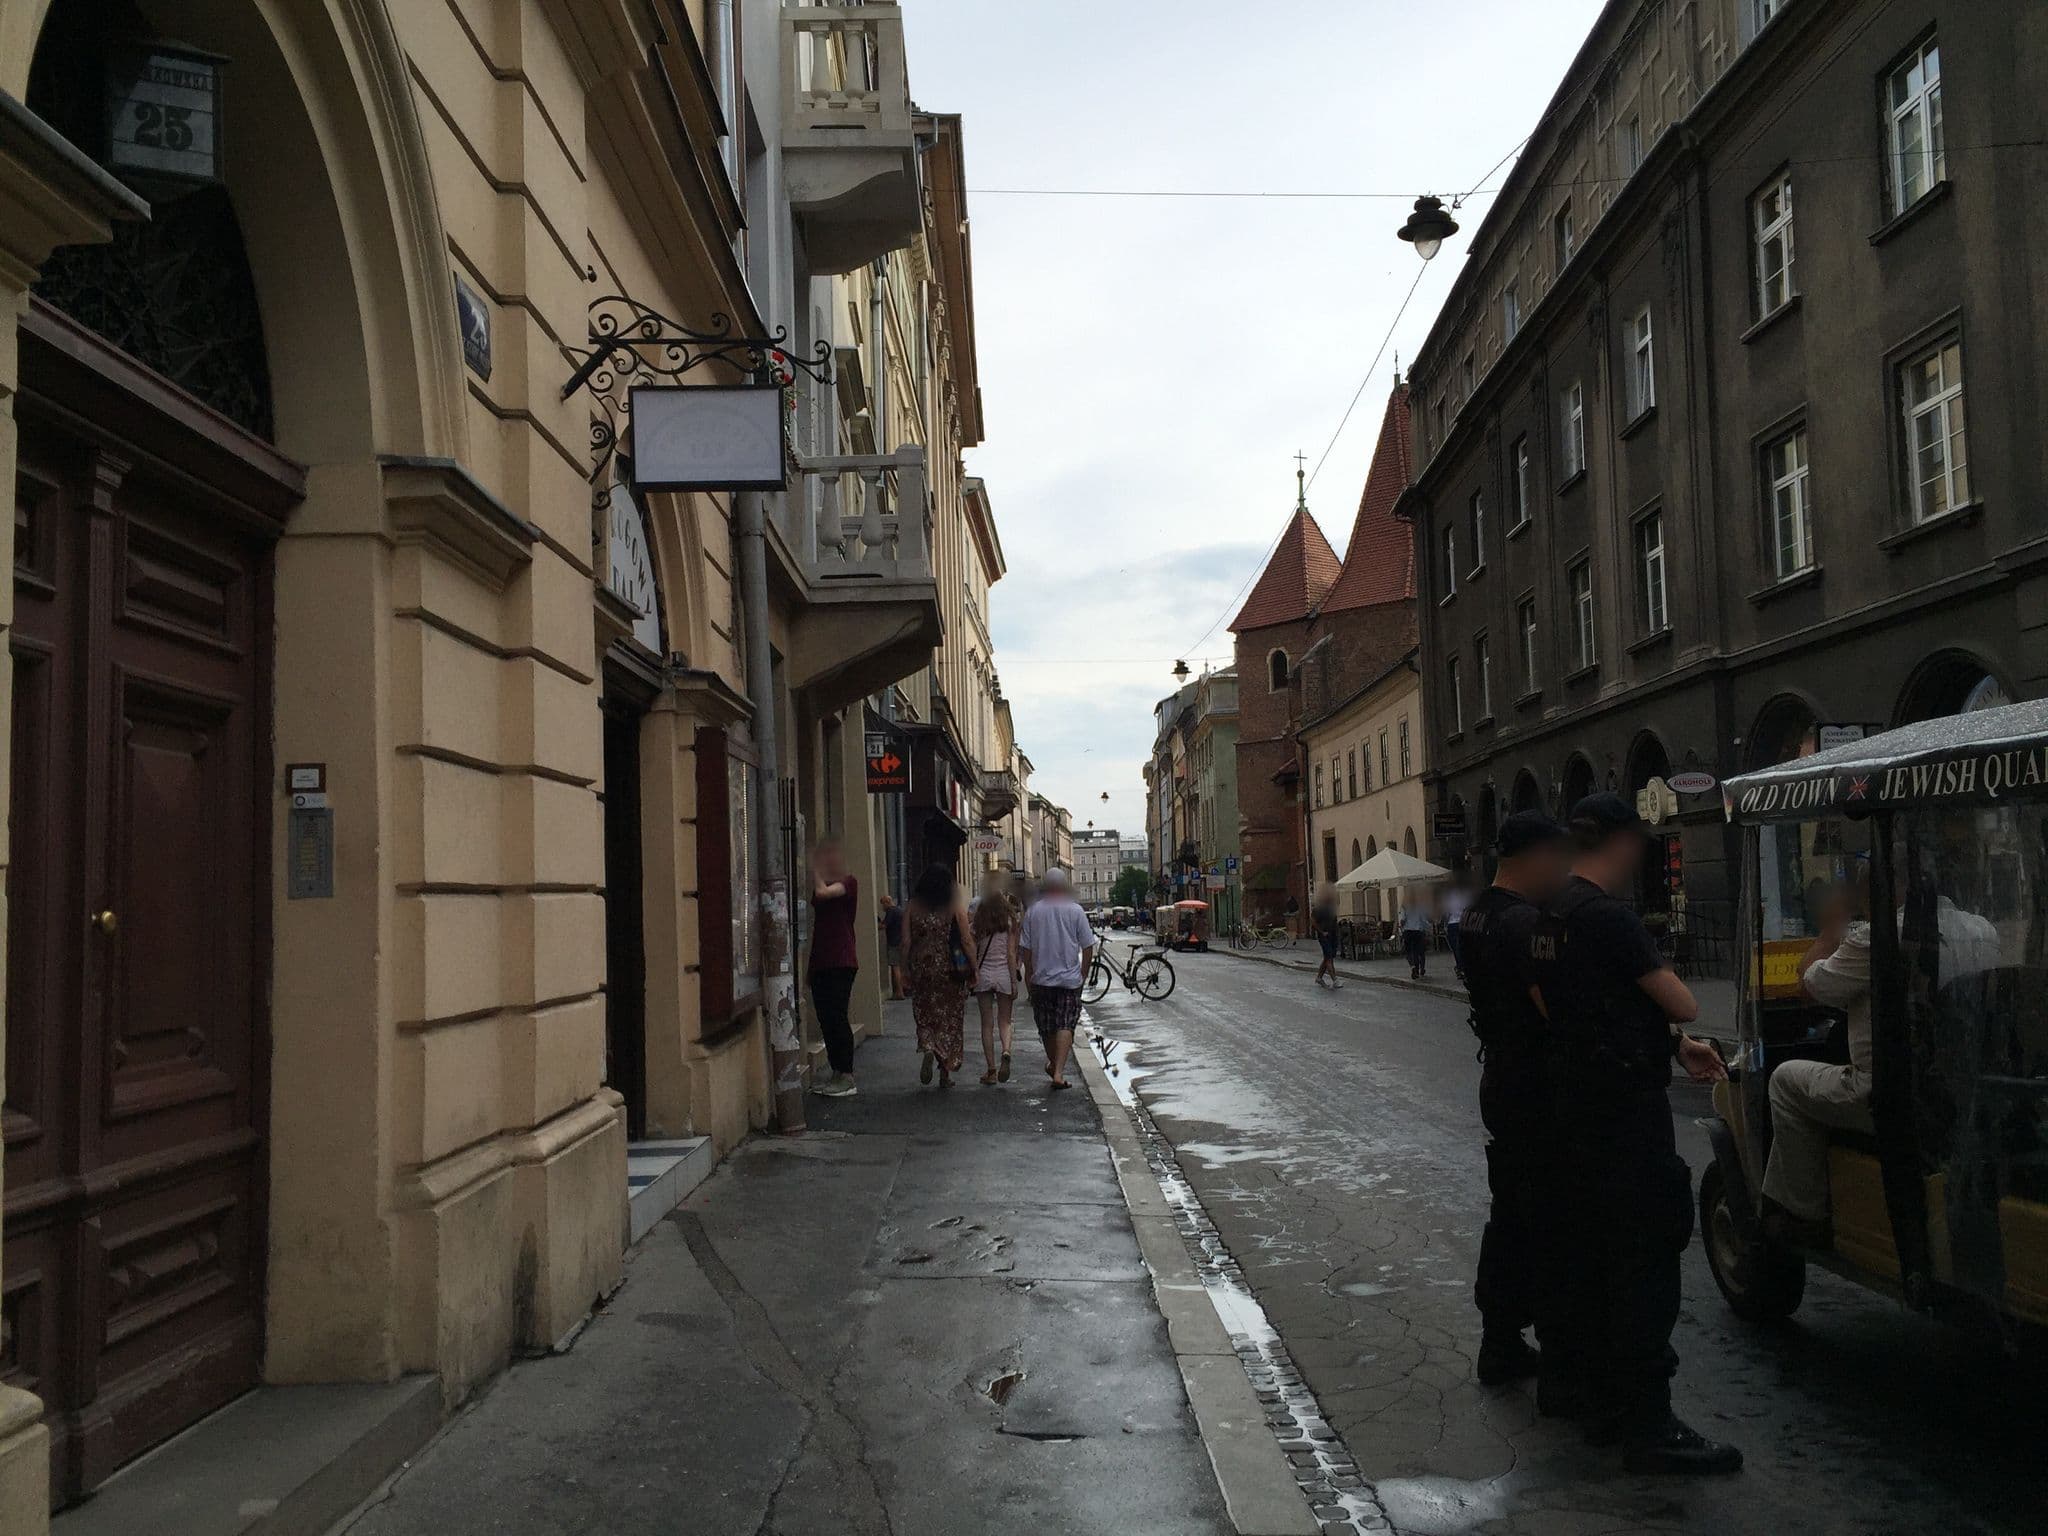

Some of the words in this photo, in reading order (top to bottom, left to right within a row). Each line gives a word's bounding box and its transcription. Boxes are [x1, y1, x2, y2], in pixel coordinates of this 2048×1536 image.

[134, 102, 194, 152] 25
[868, 776, 905, 787] express
[1740, 785, 1779, 814] OLD
[1780, 776, 1842, 810] TOWN
[1879, 758, 1978, 801] JEWISH
[1983, 747, 2048, 799] QUA
[976, 841, 999, 850] LODY
[1227, 859, 1236, 869] P
